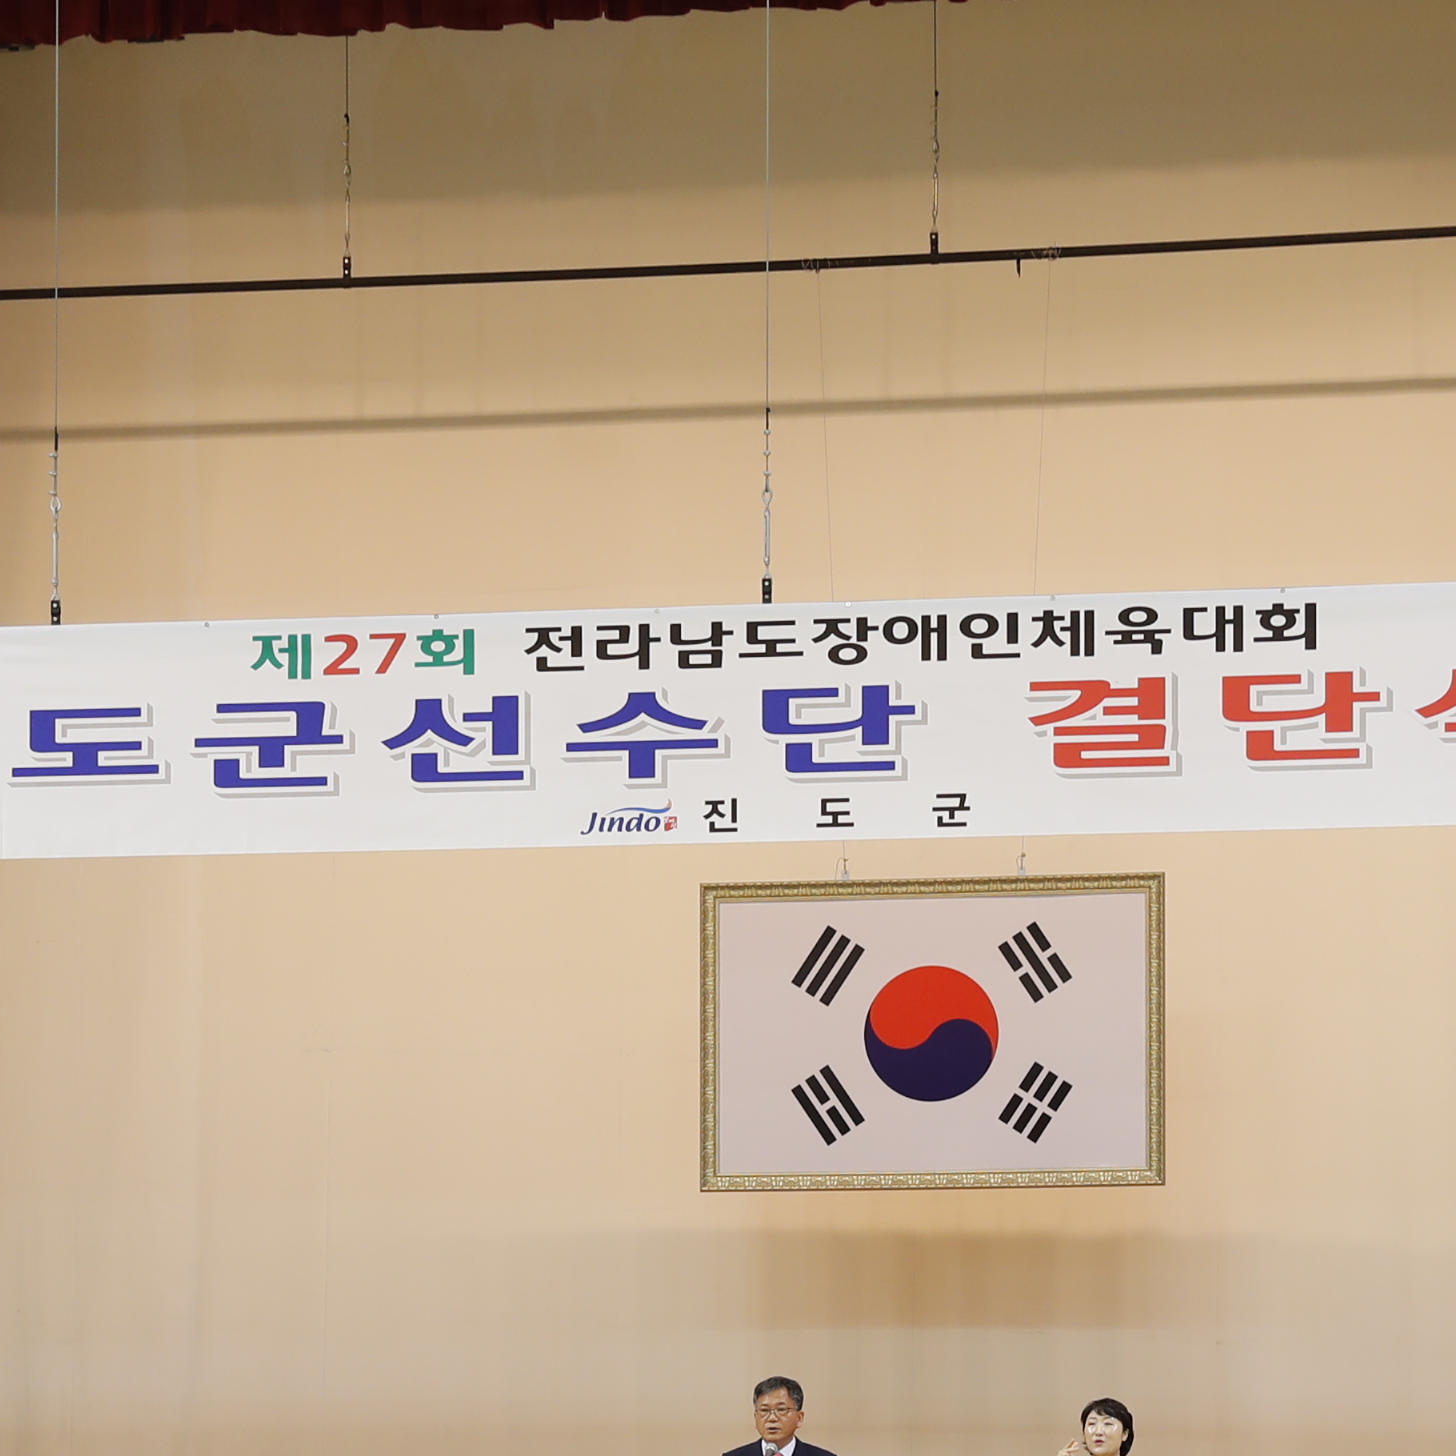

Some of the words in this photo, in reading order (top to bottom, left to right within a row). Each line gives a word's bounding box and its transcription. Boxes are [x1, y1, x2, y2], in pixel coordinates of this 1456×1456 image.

[250, 628, 476, 680] 제27회
[523, 602, 1319, 673] 전라남도장애인체육대회
[580, 812, 661, 835] Jindo
